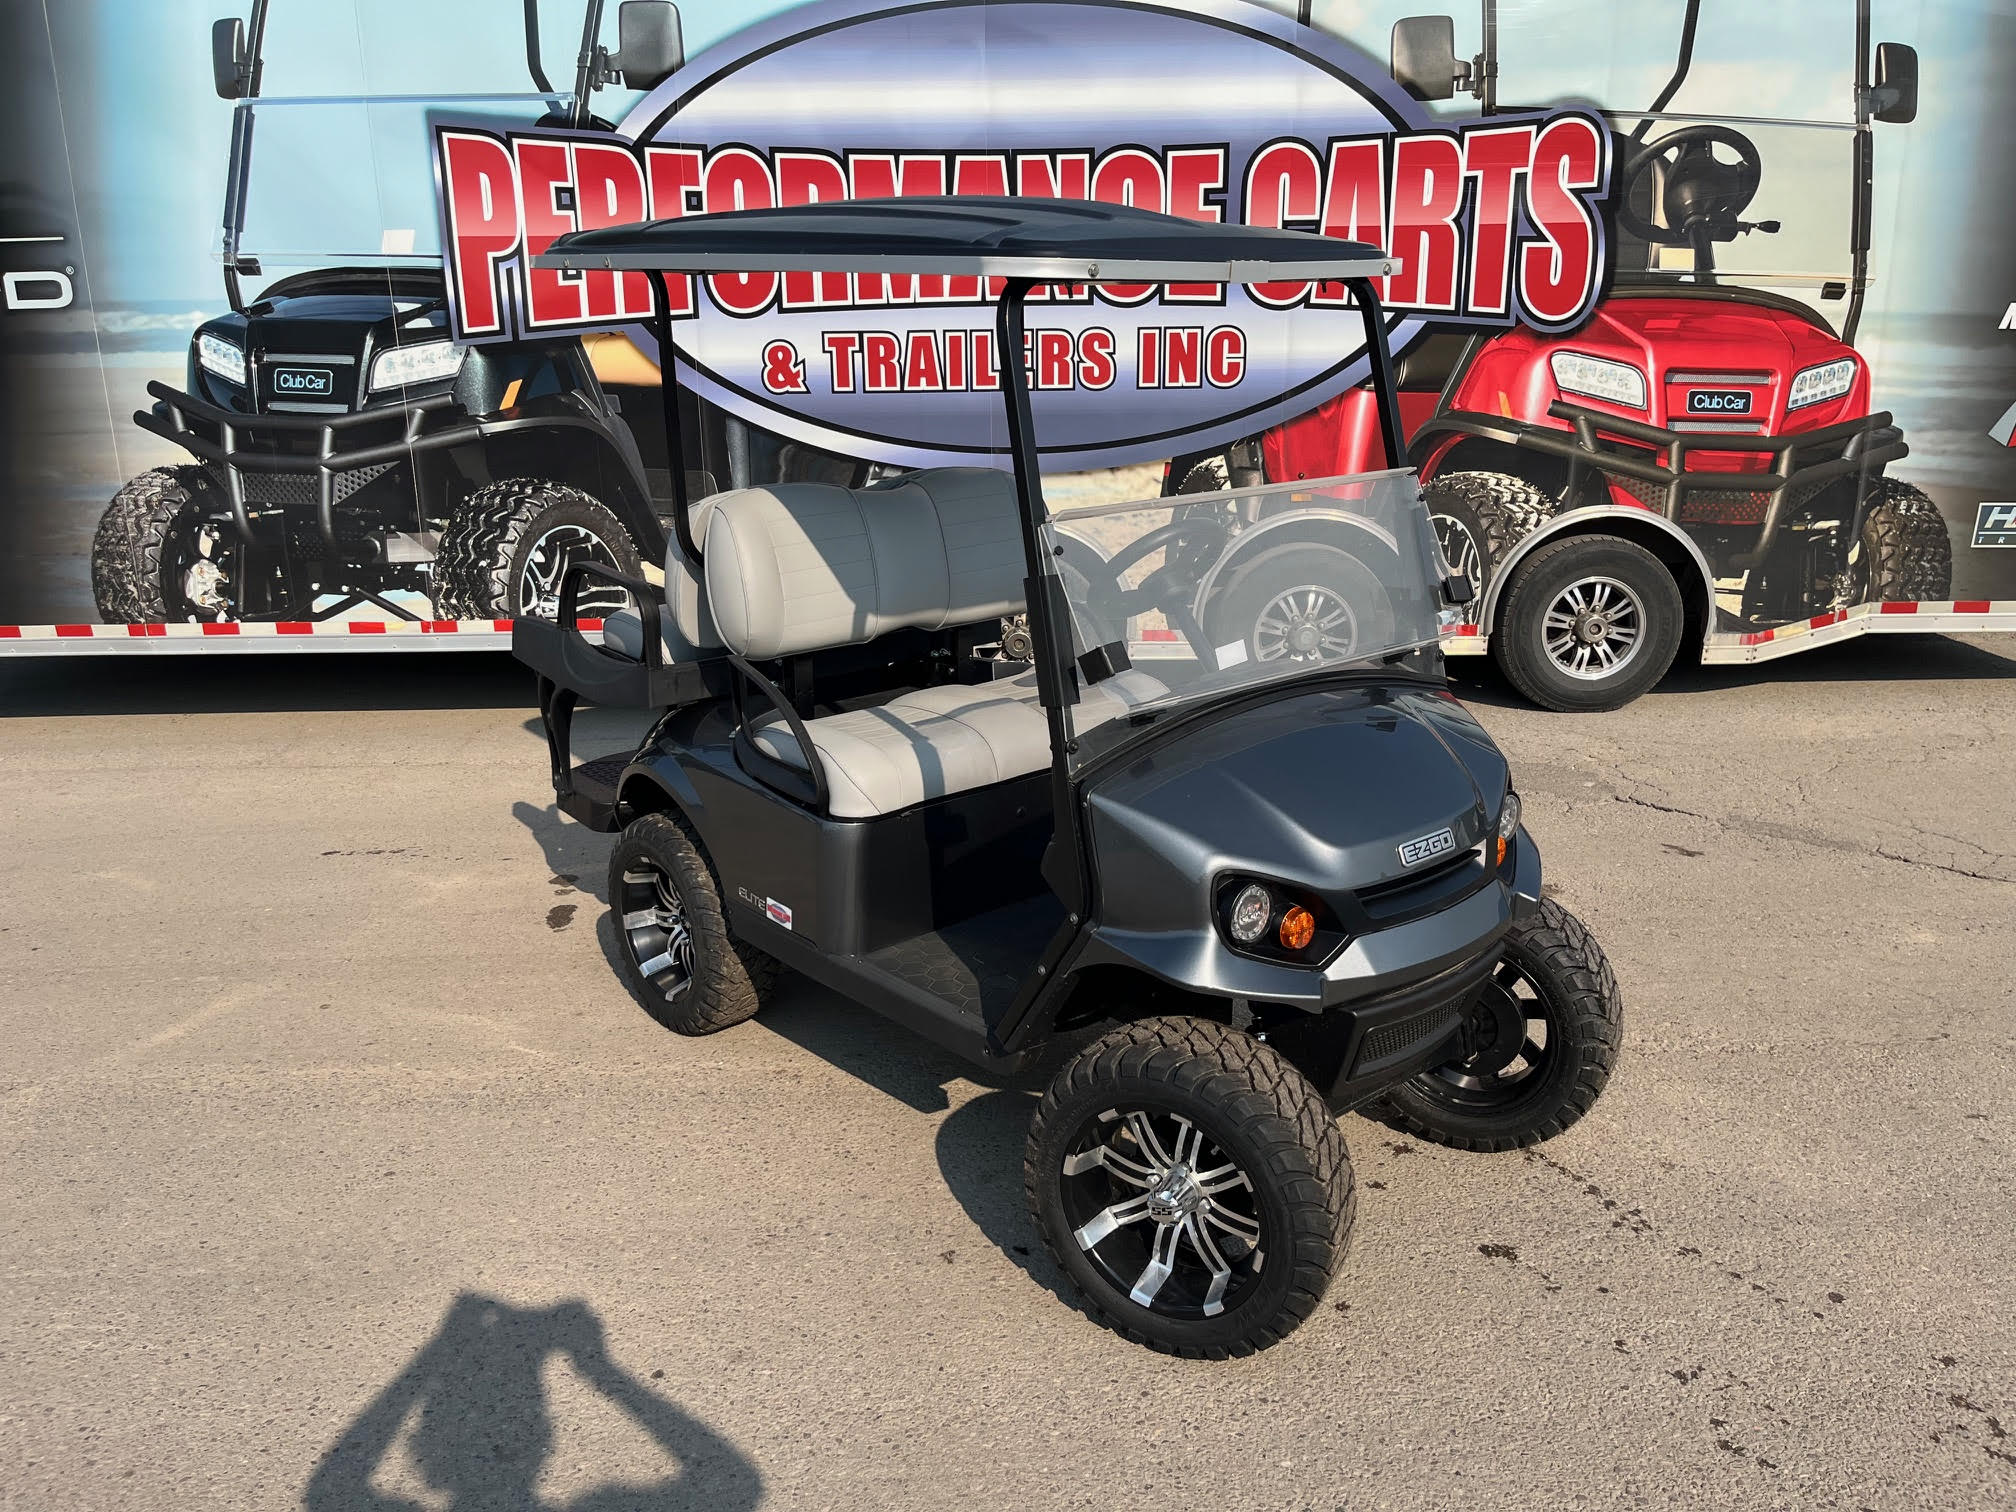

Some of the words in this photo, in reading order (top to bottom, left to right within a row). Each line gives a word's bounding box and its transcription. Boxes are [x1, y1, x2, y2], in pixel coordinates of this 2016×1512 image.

[1245, 116, 1601, 322] CARTS
[764, 341, 809, 392] &
[1138, 325, 1247, 389] INC
[280, 374, 305, 388] Club
[305, 375, 326, 389] Car
[1694, 394, 1722, 409] Club
[1724, 395, 1746, 409] Car
[1403, 831, 1454, 863] EZGO
[739, 886, 766, 911] ELITE
